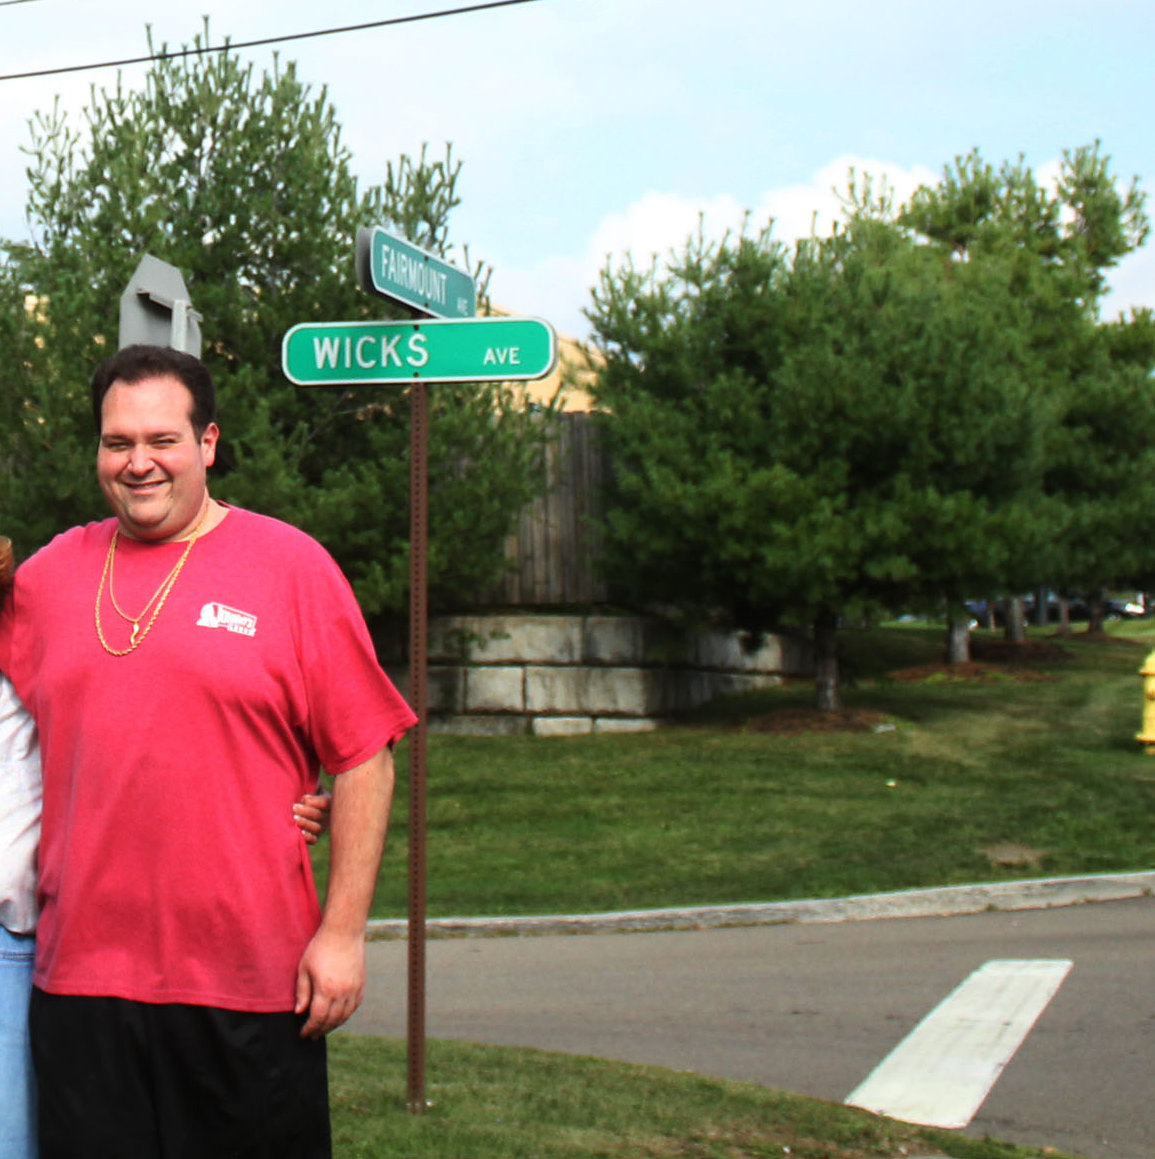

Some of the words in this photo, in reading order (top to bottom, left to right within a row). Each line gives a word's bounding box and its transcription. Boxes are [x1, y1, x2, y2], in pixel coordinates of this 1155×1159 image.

[382, 244, 446, 305] FAIRMOUNT
[313, 334, 429, 369] WICKS
[483, 348, 521, 366] AVE
